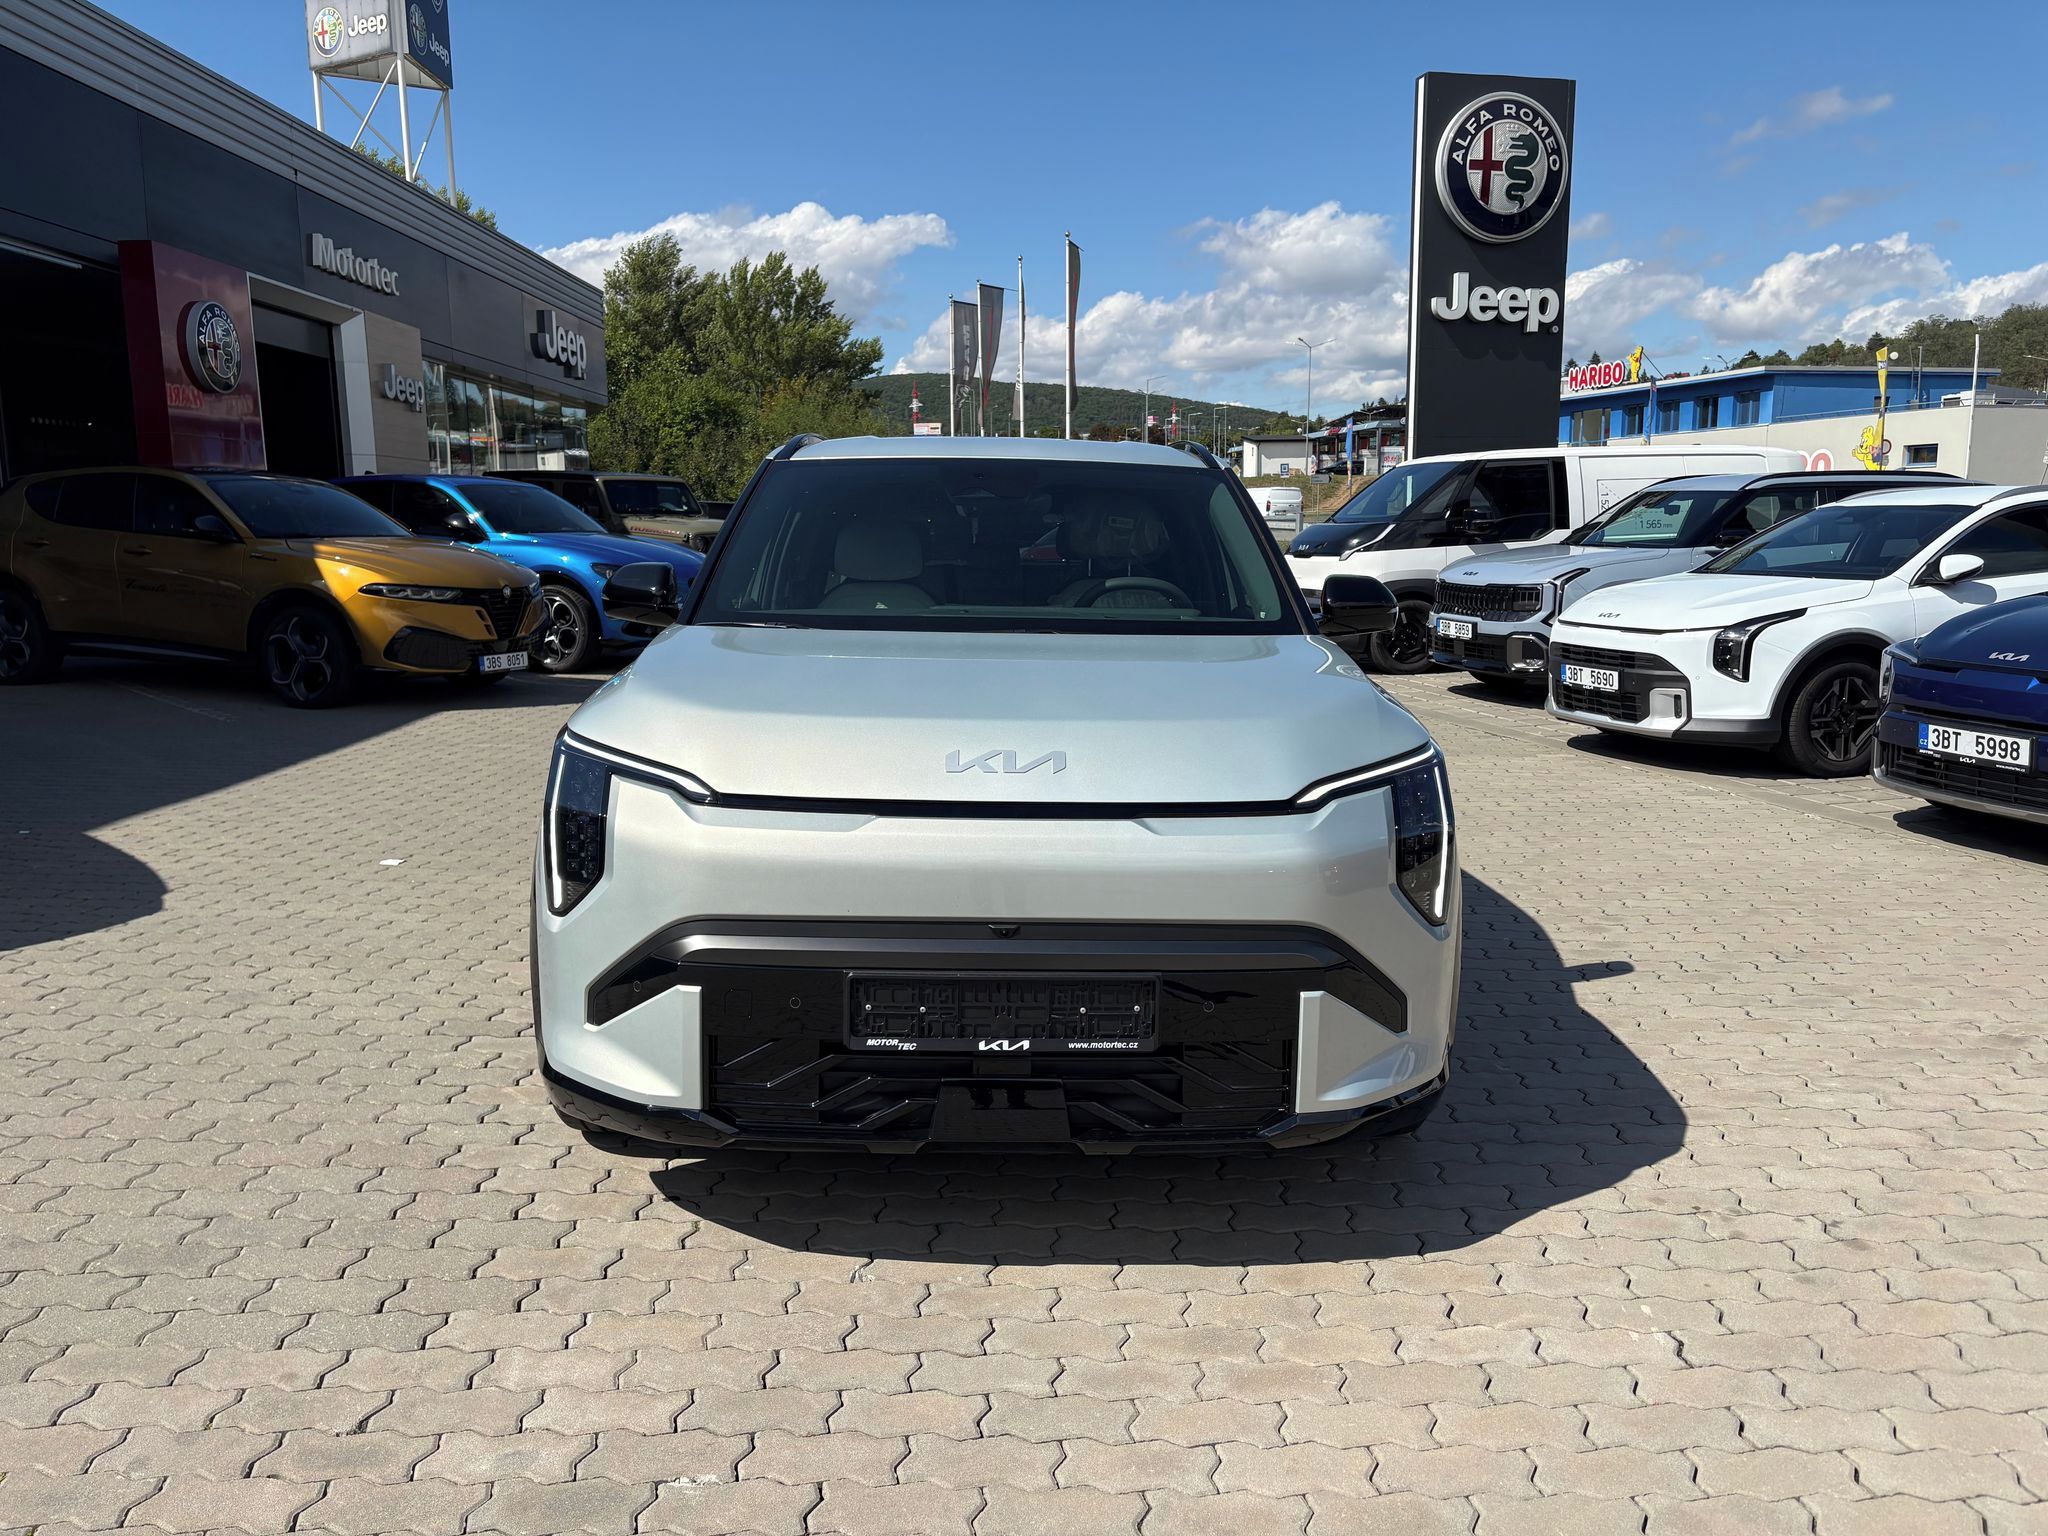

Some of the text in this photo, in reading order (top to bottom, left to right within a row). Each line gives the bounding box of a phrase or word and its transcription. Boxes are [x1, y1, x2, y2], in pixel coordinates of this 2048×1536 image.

[347, 13, 388, 37] Jeep
[429, 32, 450, 67] Jeep
[1452, 103, 1561, 173] ALFA ROMEO
[312, 232, 400, 296] Motortec
[1431, 272, 1561, 333] Jeep
[199, 310, 214, 344] ALFA
[540, 310, 587, 379] Jeep
[384, 364, 425, 411] Jeep
[1569, 360, 1626, 391] HARIBO
[1640, 520, 1644, 529] 1
[1646, 520, 1662, 529] 565
[486, 656, 502, 669] 3BS
[1988, 651, 2030, 662] KIA
[1568, 666, 1614, 687] 3BT 5690
[1919, 738, 1928, 746] CZ
[1931, 728, 2020, 761] 3BT 5998
[945, 749, 1067, 774] KIA
[866, 1038, 917, 1051] MOTOR TEC
[978, 1039, 1030, 1051] KIA
[1068, 1041, 1139, 1049] www.motortec.cz
